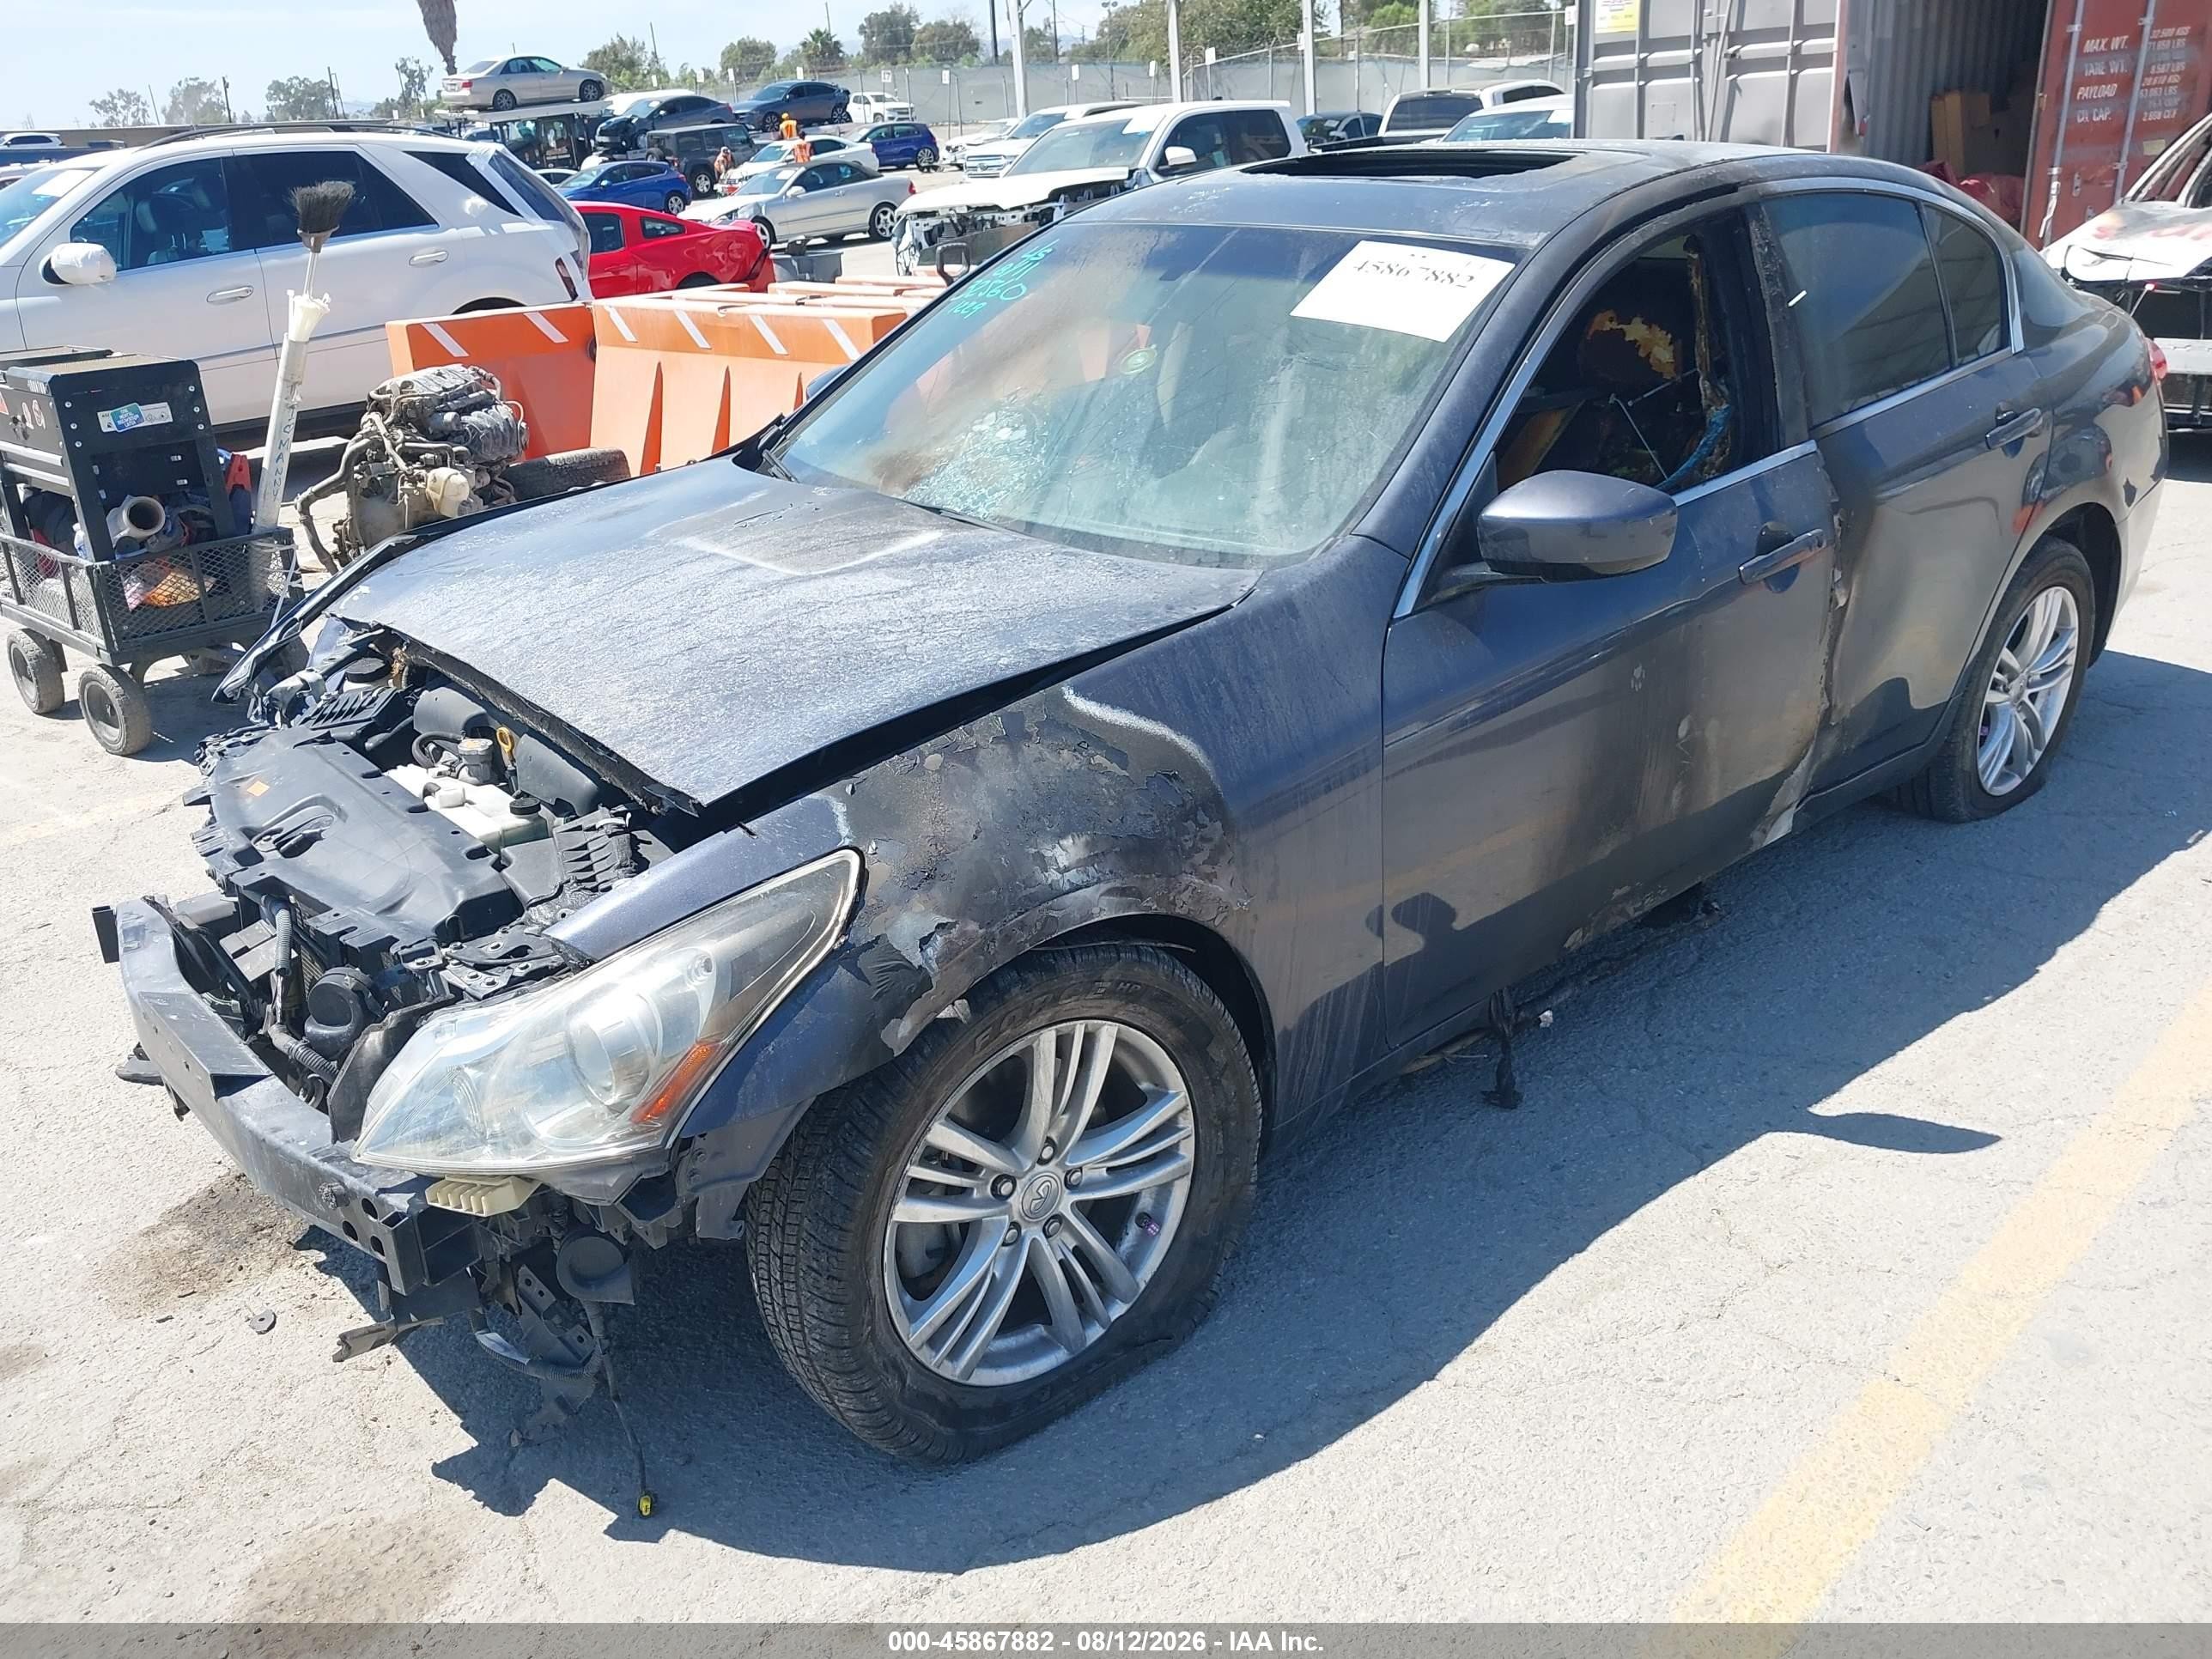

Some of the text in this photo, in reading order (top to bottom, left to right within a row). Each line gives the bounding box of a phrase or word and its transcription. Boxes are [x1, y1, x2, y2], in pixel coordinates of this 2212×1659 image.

[2111, 35, 2129, 50] WT.
[2076, 83, 2118, 100] PAYLOAD
[2092, 106, 2112, 121] CAP.
